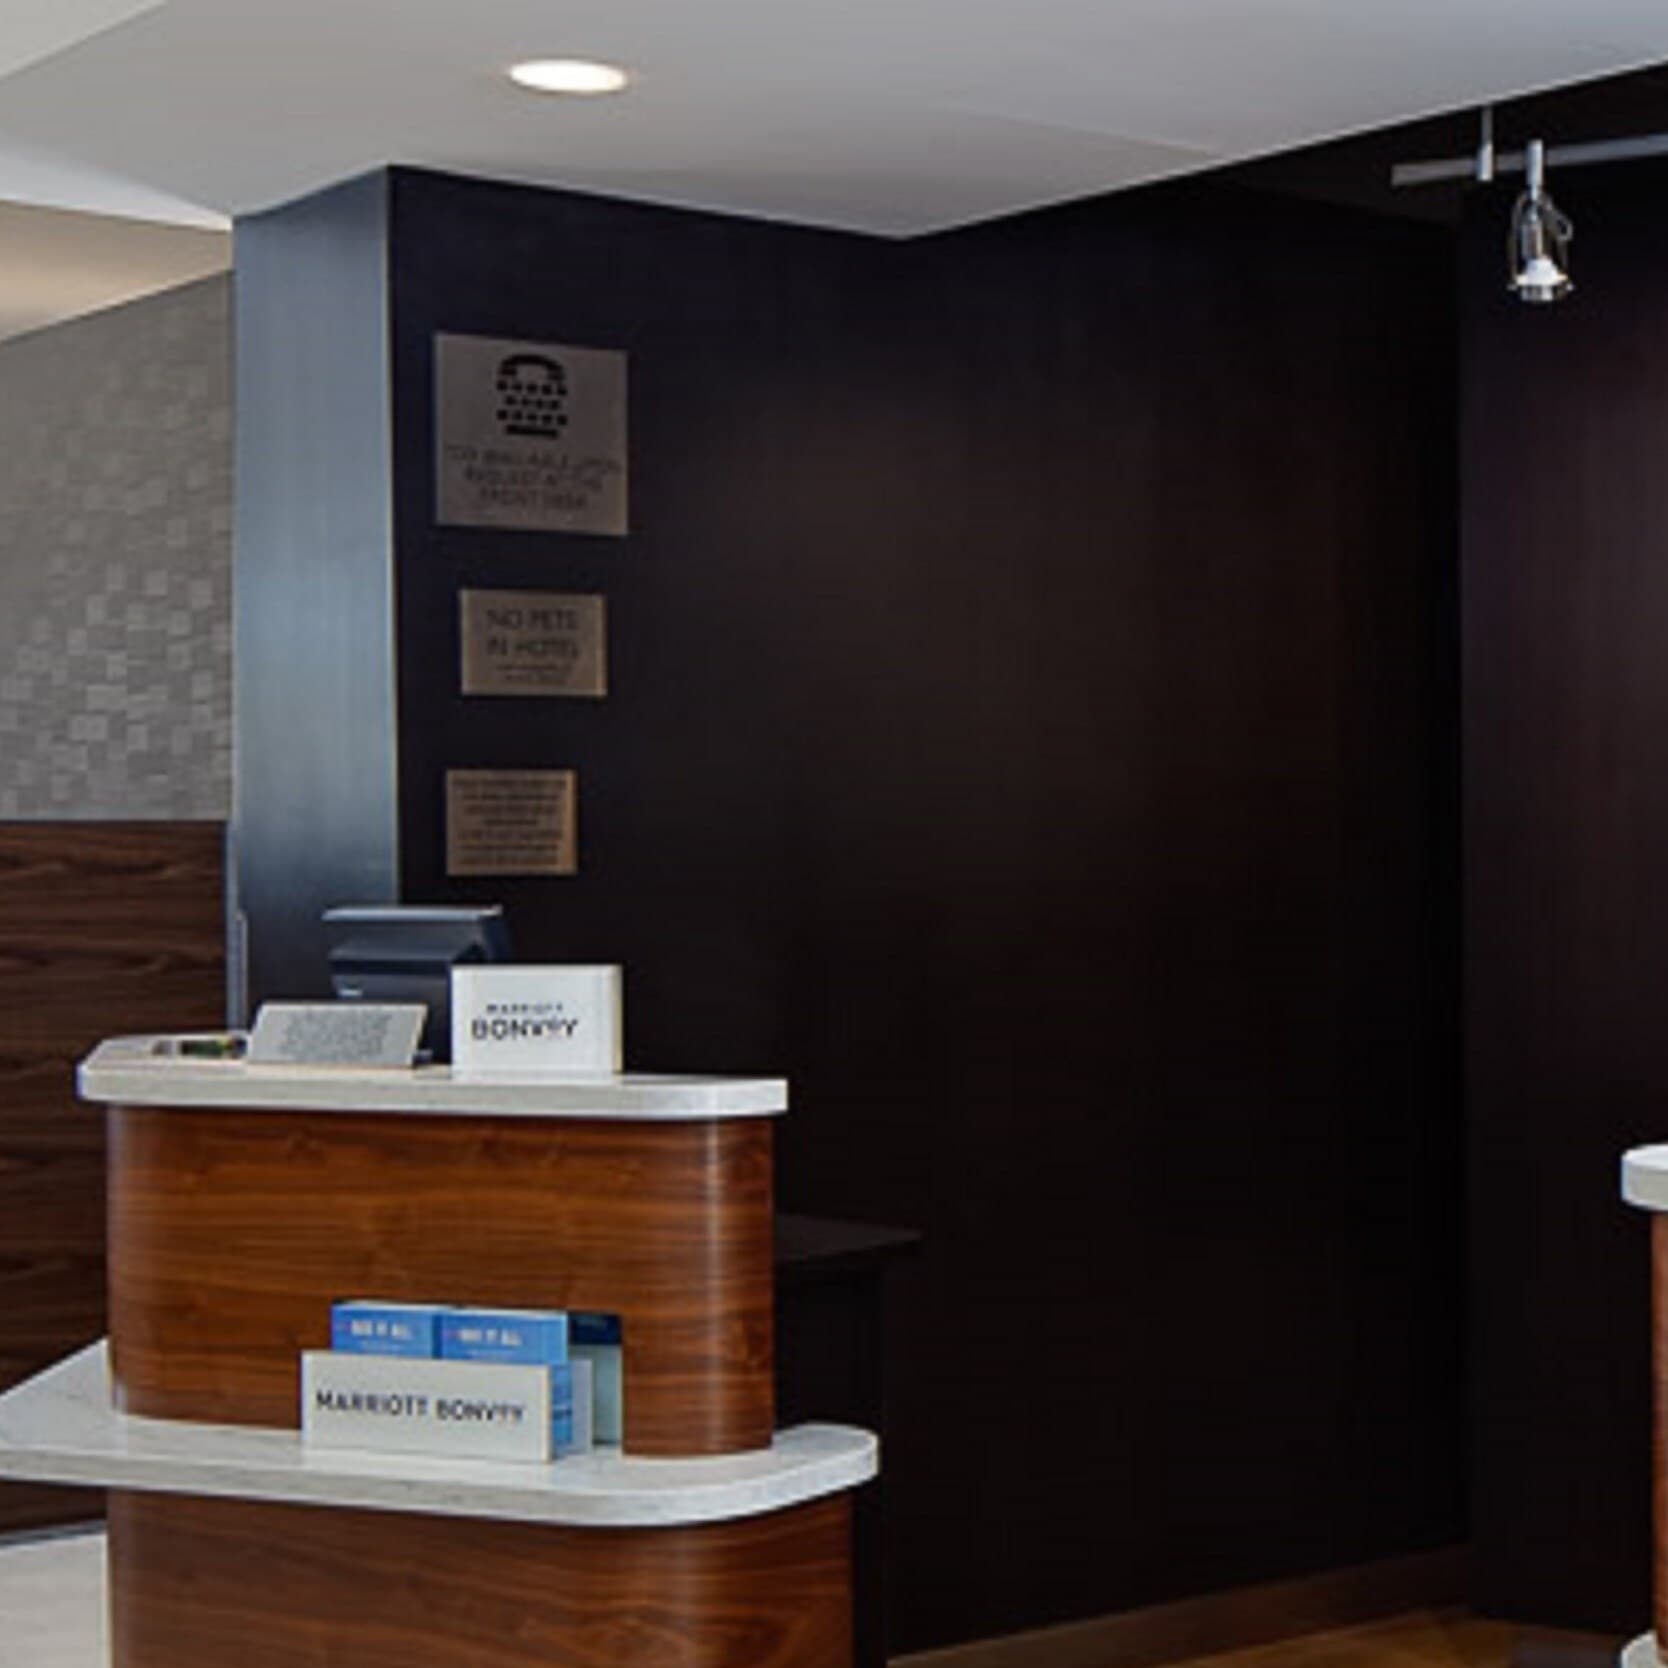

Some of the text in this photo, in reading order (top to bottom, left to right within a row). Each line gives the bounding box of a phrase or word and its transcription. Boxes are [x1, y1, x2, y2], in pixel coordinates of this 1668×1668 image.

[486, 609, 579, 631] NO PETS
[486, 636, 580, 660] IN HOTEL
[316, 1388, 429, 1417] MARRIOTT
